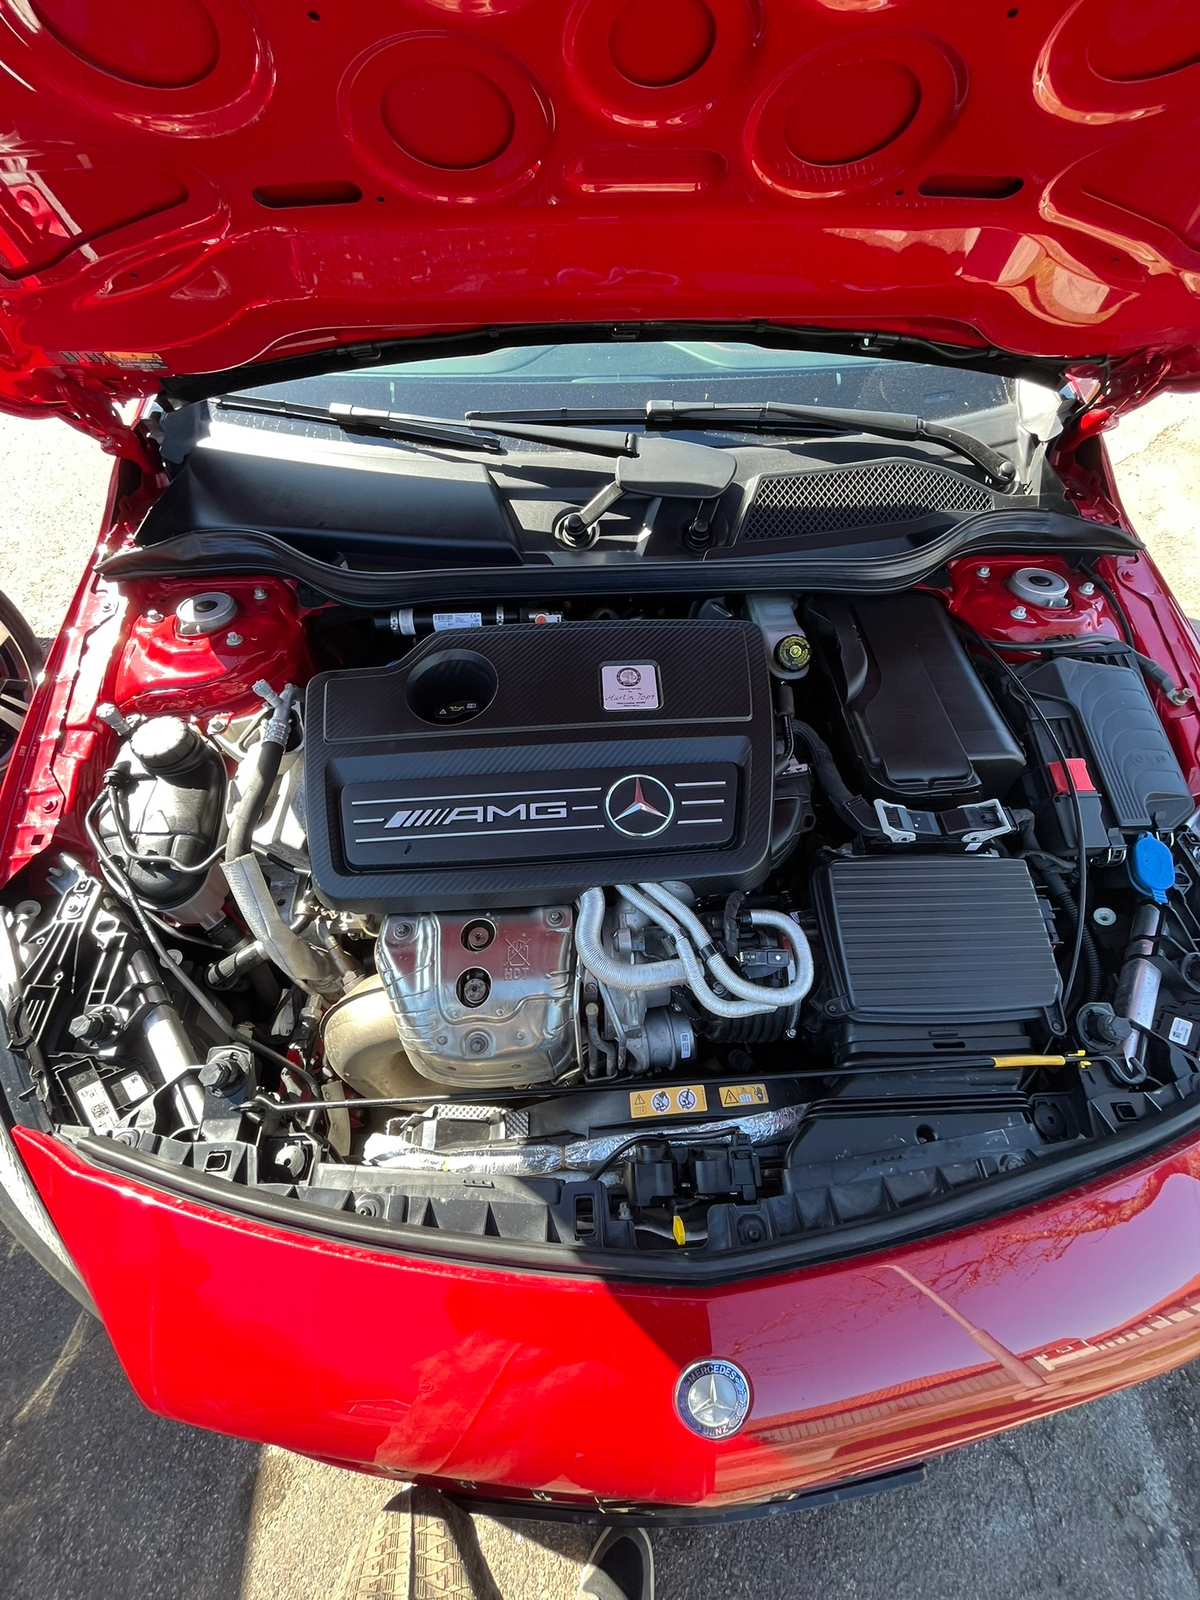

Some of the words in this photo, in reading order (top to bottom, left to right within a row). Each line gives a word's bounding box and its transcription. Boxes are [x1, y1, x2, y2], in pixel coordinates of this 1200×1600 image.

[504, 967, 530, 980] HOT
[687, 1364, 738, 1384] MERCEDES
[701, 1423, 730, 1437] BENZ
